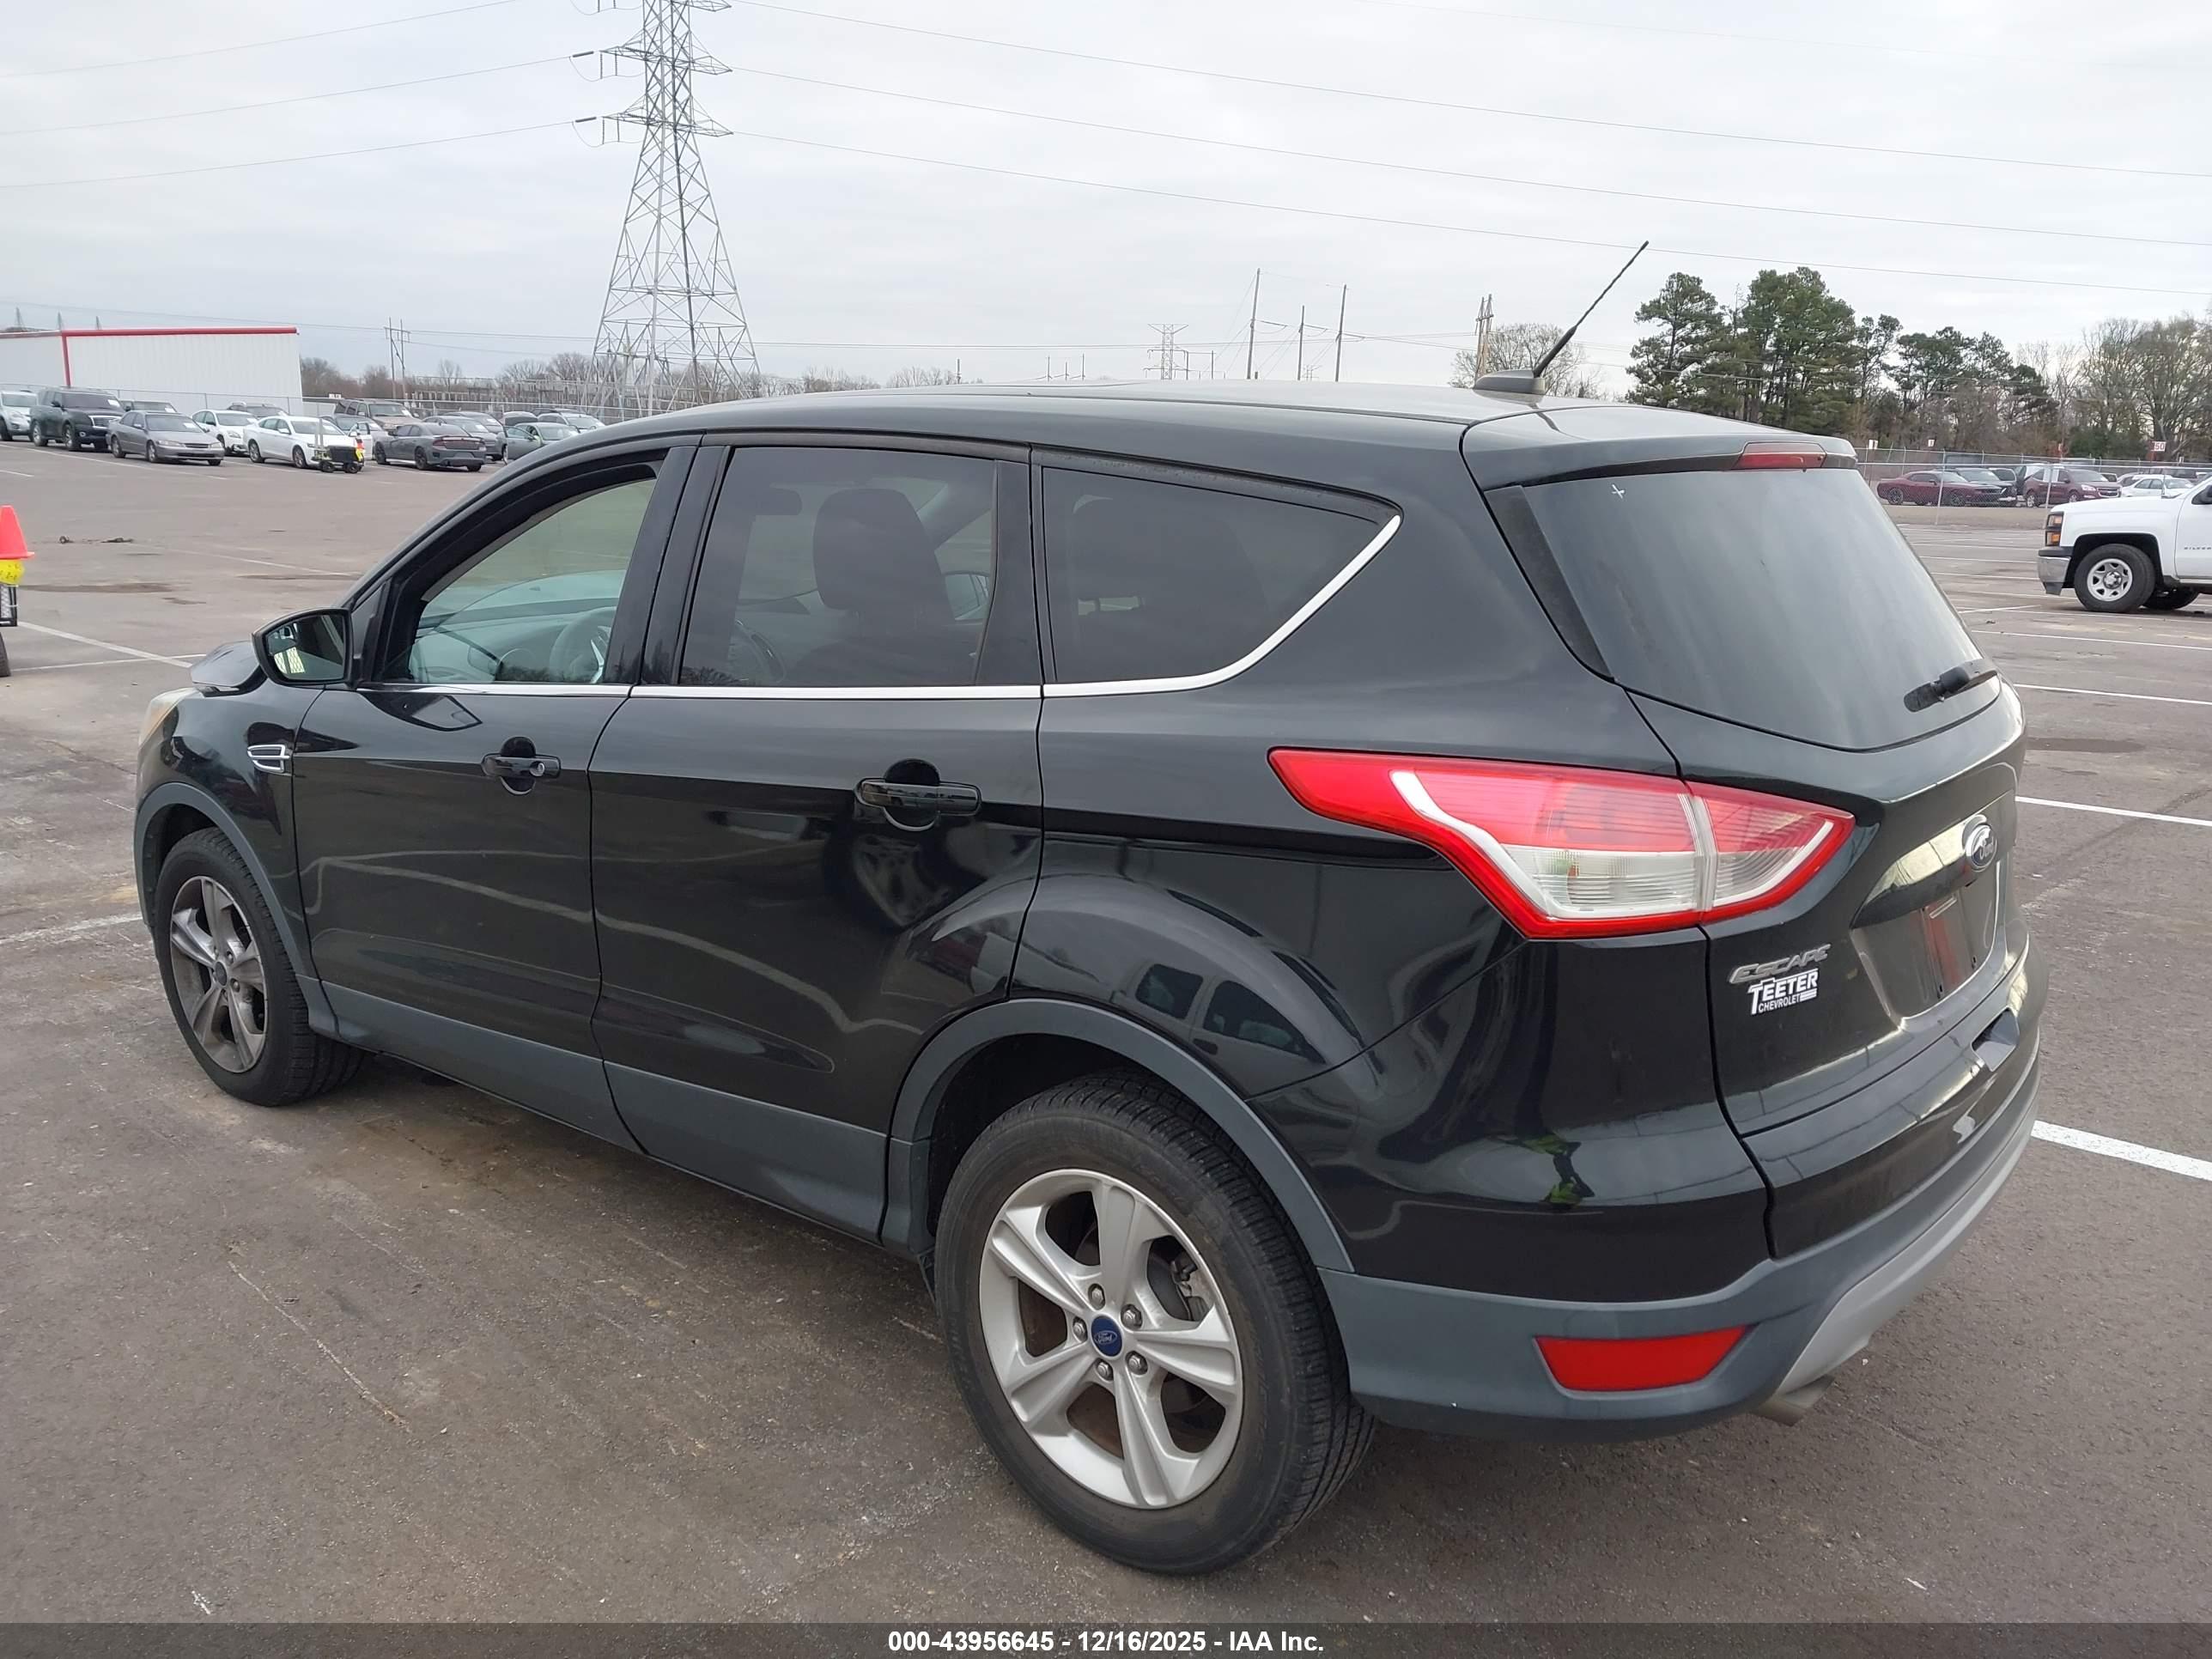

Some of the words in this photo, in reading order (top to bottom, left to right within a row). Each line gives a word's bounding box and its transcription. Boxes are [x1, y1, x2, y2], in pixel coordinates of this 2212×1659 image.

[1729, 944, 1832, 985] ESCAPE
[1748, 969, 1819, 1016] TEETER
[1758, 994, 1802, 1013] CHEVROLET
[1097, 1332, 1113, 1344] Ford
